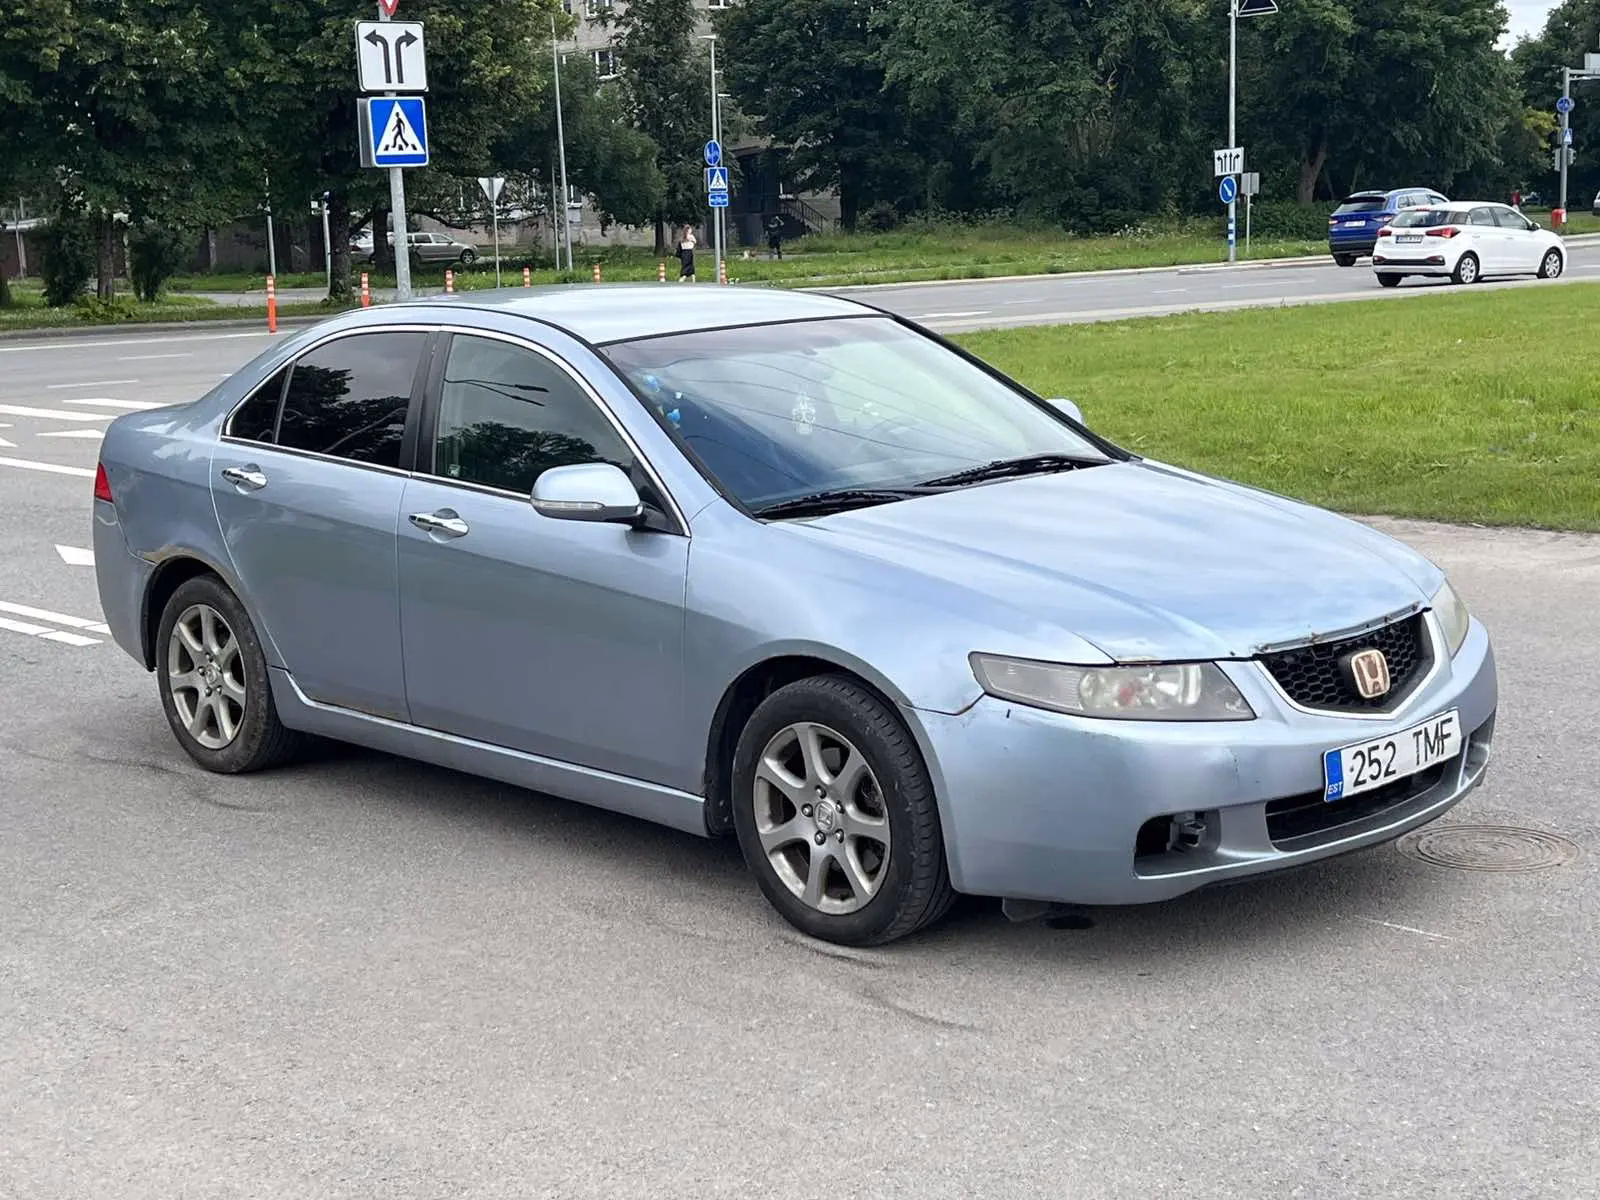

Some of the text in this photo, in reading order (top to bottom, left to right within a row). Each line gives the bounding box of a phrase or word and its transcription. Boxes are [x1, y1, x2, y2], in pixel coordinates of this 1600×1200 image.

[1352, 718, 1453, 787] 252 TMF
[1328, 782, 1342, 794] EST
